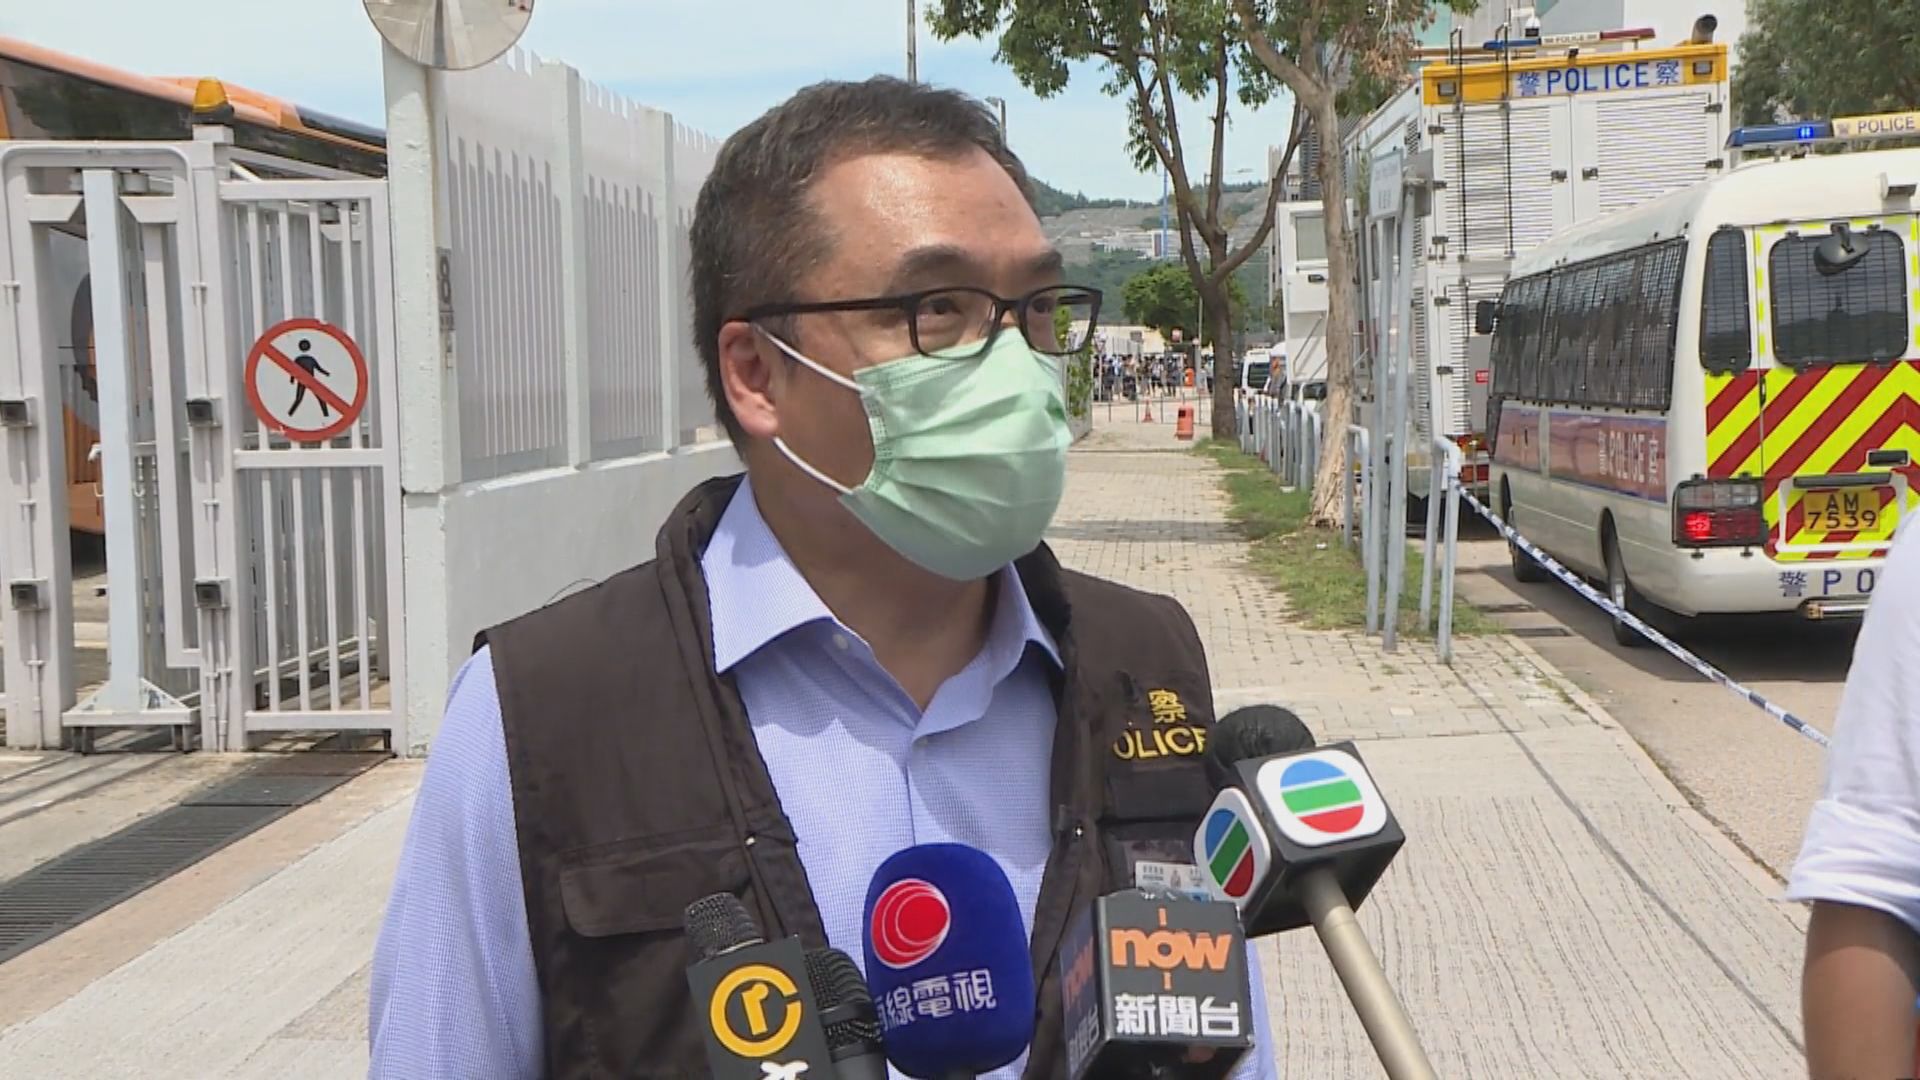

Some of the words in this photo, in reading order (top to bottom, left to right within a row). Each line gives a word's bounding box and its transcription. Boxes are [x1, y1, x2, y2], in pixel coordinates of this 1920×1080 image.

[1517, 71, 1541, 96] 警
[1546, 63, 1649, 95] POLICE
[1656, 60, 1680, 85] 察
[1857, 116, 1916, 134] POLICE
[1609, 430, 1646, 483] POLICE
[1825, 493, 1859, 515] AM
[1807, 510, 1877, 530] 7539
[1778, 570, 1808, 597] 警
[1111, 928, 1232, 970] now
[1114, 992, 1240, 1037] 新聞台
